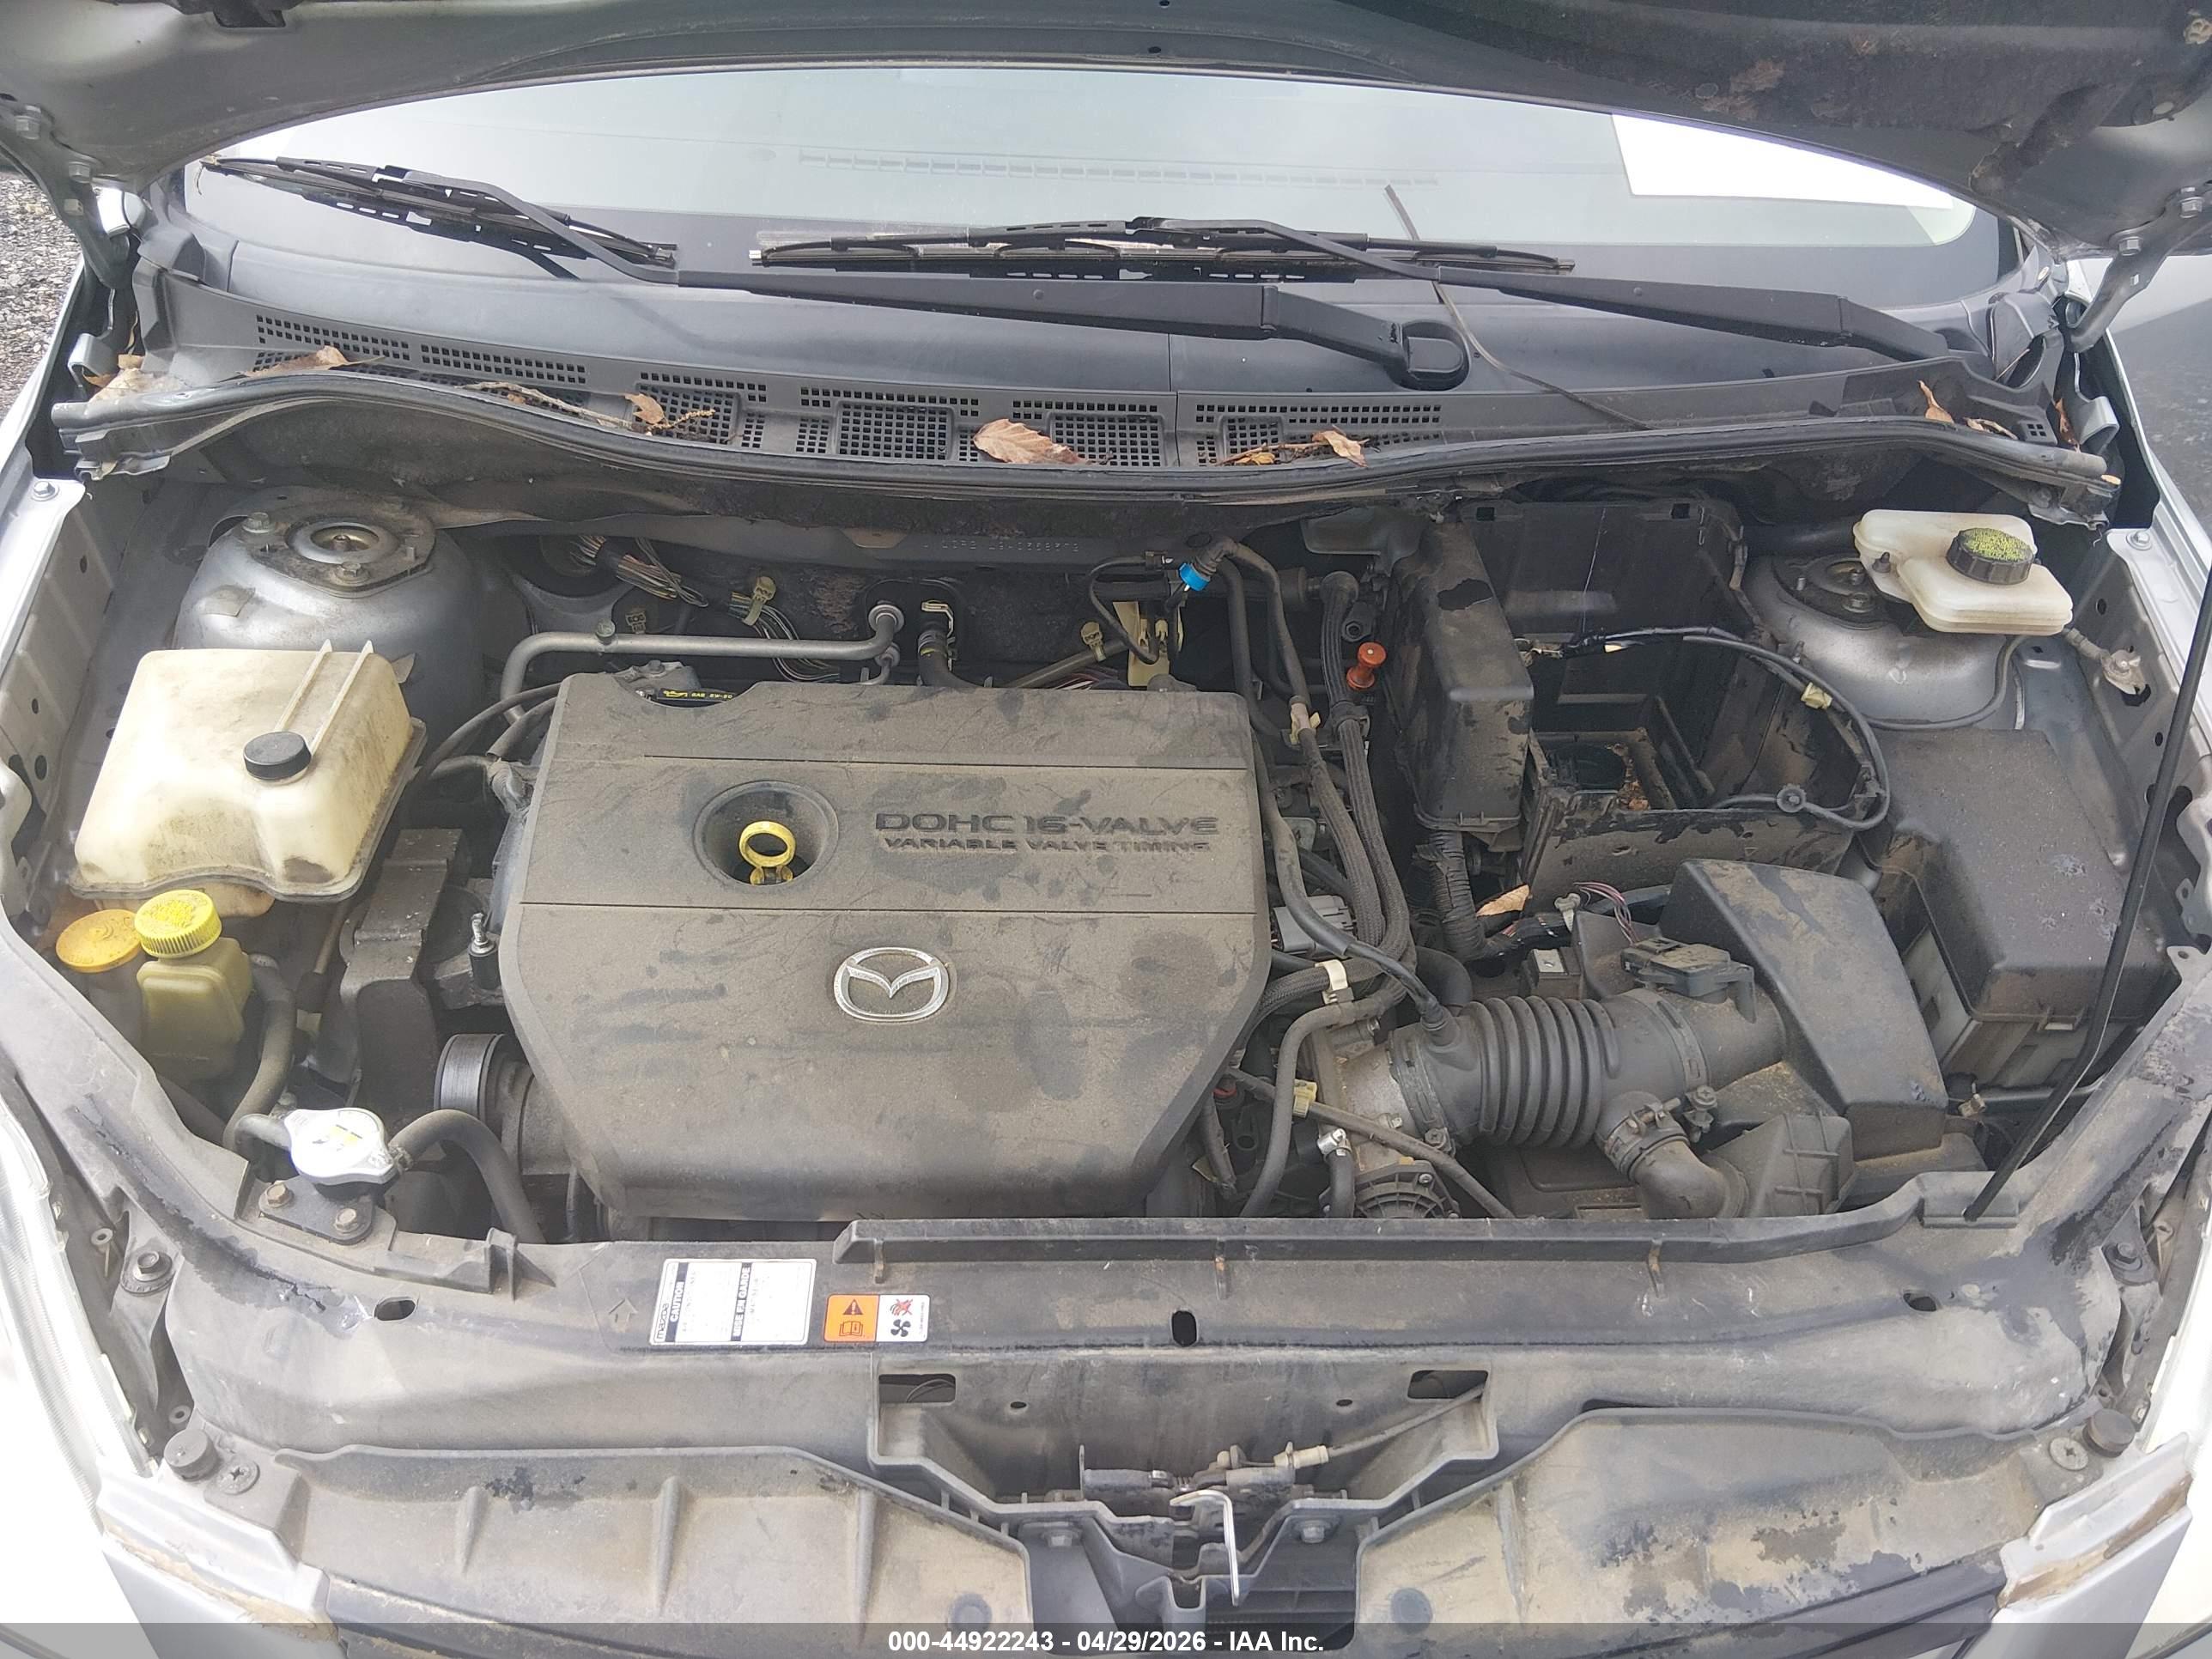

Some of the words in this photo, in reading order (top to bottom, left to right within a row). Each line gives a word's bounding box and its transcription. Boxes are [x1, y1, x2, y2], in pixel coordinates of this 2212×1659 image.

[875, 812, 1013, 834] DOHC
[1023, 814, 1219, 836] 16-VALVE
[884, 837, 1018, 851] VARIABLE
[1029, 840, 1108, 852] VALVE
[1113, 841, 1211, 853] TIMING
[669, 1280, 685, 1323] CAUTION
[732, 1313, 744, 1337] MISE
[738, 1267, 751, 1299] GARDE
